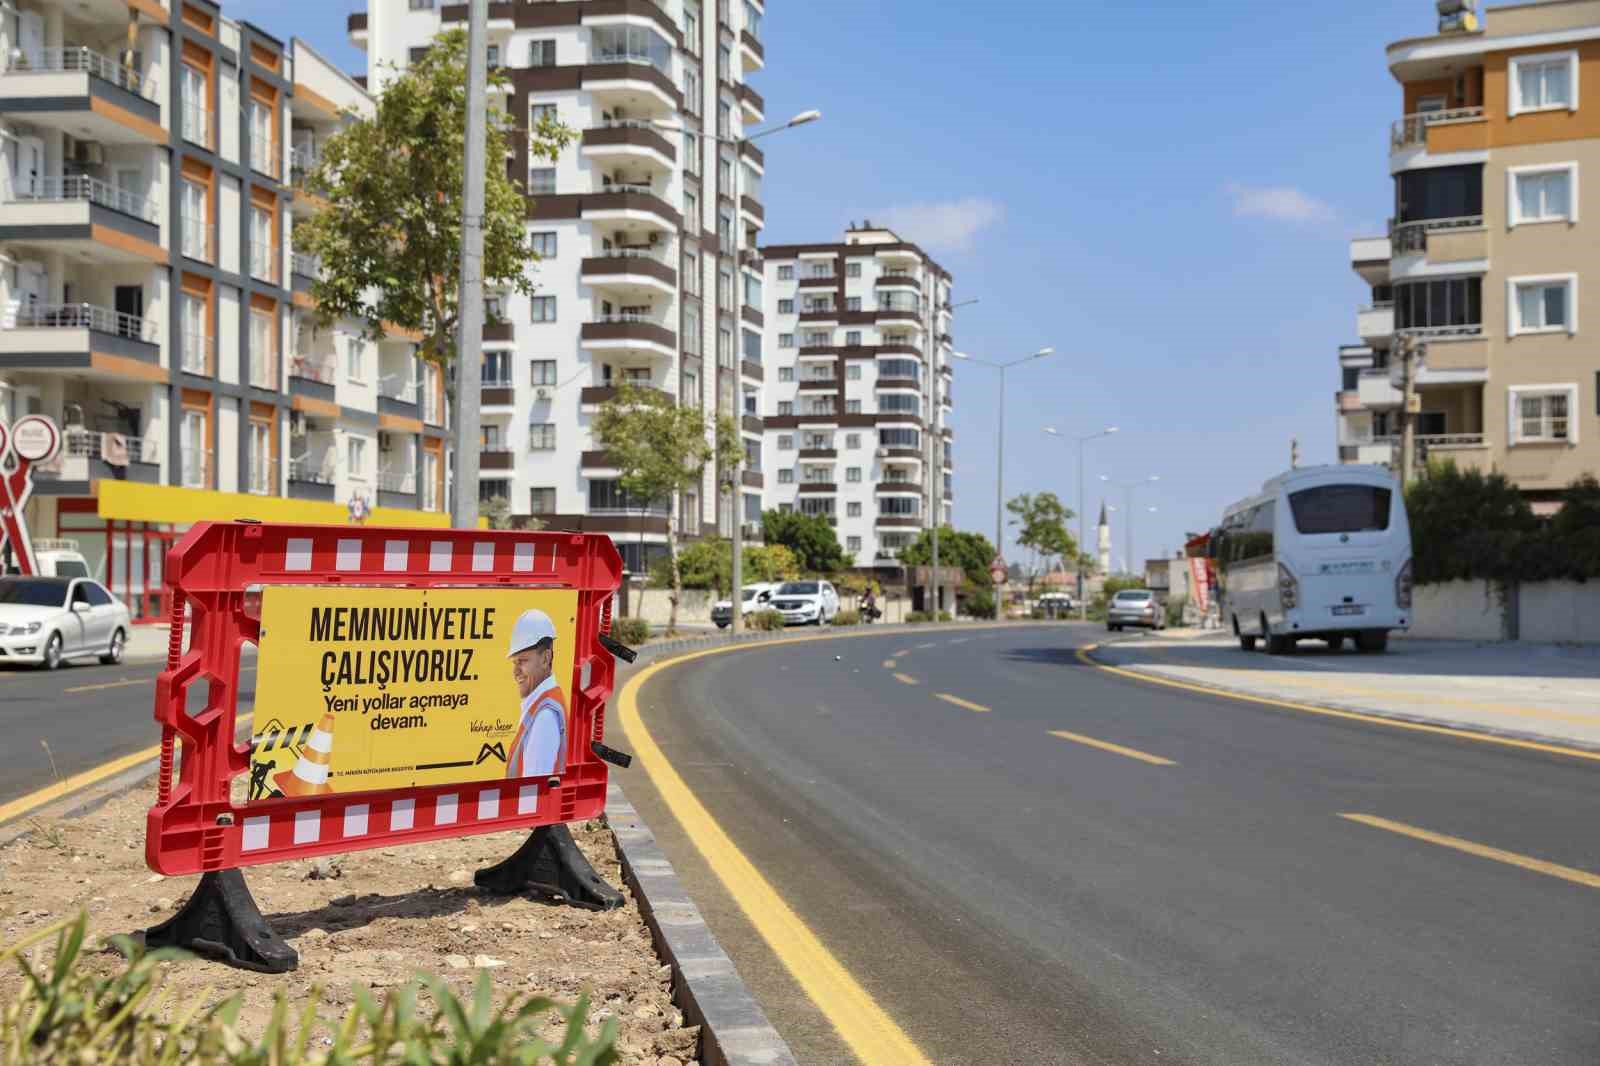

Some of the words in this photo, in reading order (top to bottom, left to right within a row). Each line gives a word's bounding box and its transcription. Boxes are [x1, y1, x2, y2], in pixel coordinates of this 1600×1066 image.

[309, 602, 496, 641] MEMNUNİYETLE
[320, 649, 479, 692] ÇALIŞIYORUZ.
[323, 695, 359, 712] Yeni
[361, 694, 406, 714] yollar
[409, 693, 469, 712] açmaya
[370, 714, 428, 730] devam.
